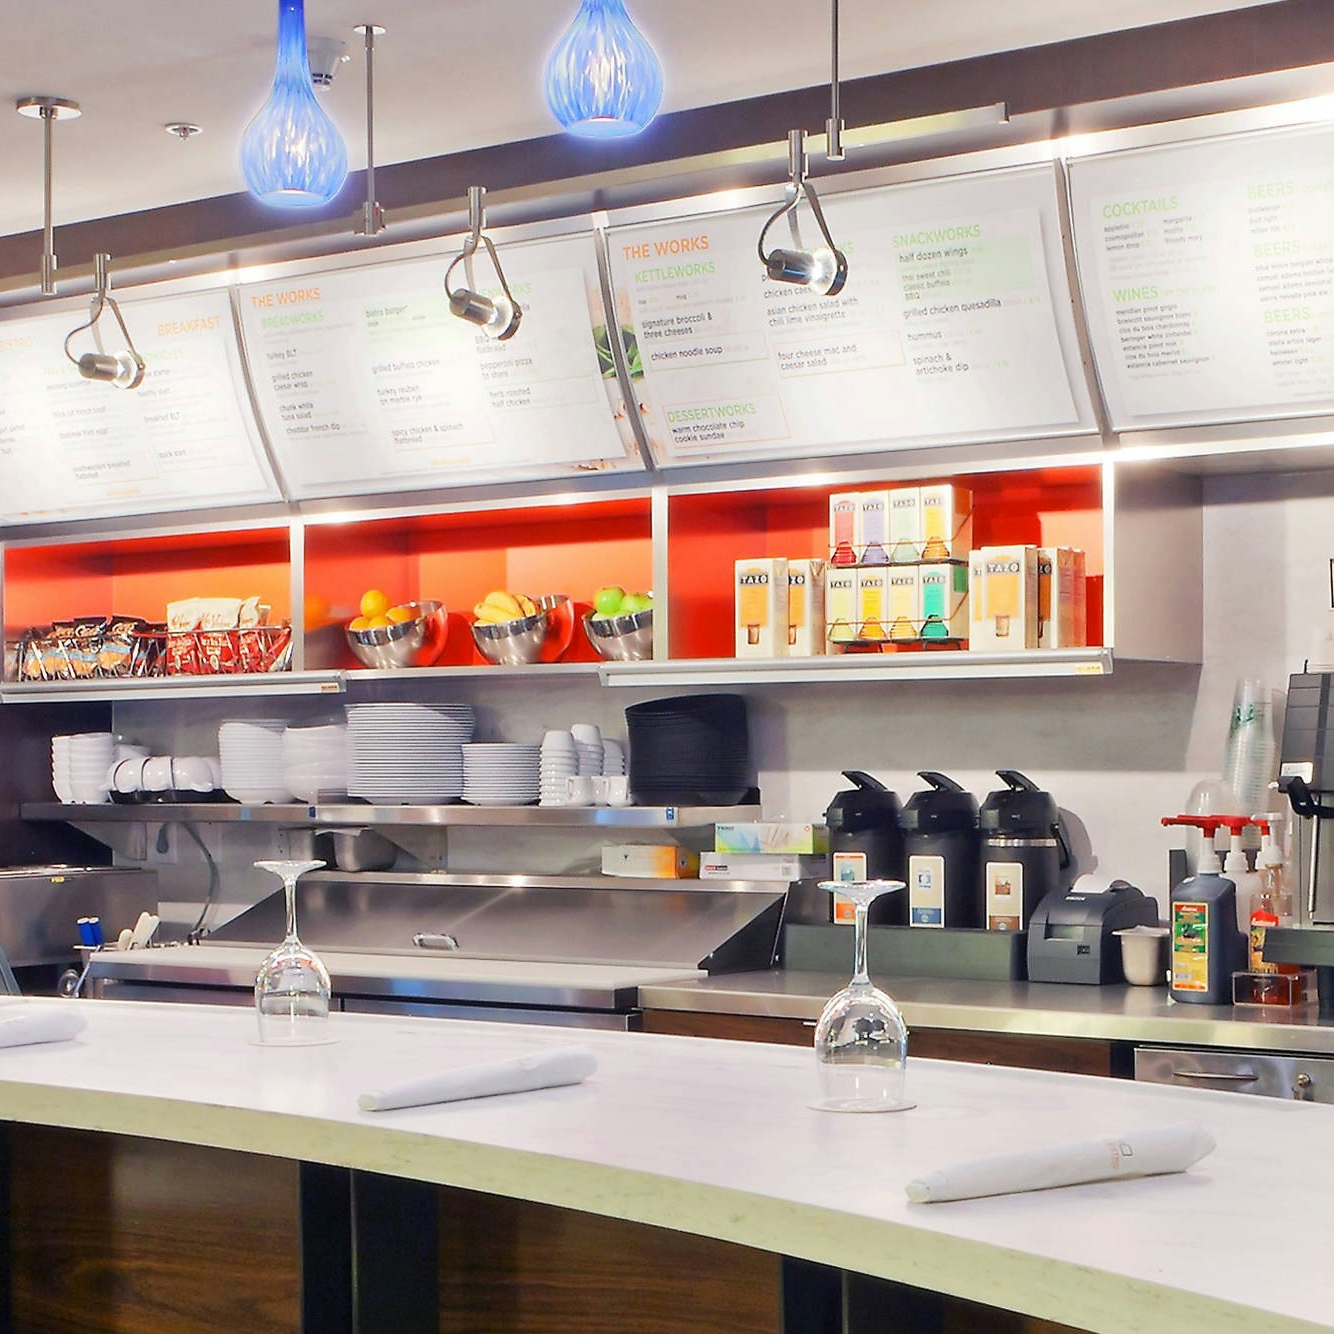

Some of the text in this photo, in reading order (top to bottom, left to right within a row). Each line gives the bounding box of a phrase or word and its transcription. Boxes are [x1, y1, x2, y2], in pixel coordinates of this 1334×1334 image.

[1248, 181, 1294, 200] BEERS
[1103, 196, 1178, 219] COCKTAILS
[892, 225, 980, 248] SNACKWORKS
[623, 236, 709, 260] THE WORKS
[917, 250, 942, 260] dozen
[944, 247, 968, 256] wings
[1254, 241, 1300, 258] BEERS
[635, 262, 715, 283] KETTLEWORKS
[252, 287, 321, 308] THE WORKS
[1113, 286, 1158, 303] WINES
[805, 311, 845, 323] vinaigrette
[903, 307, 928, 320] grilled
[961, 298, 1001, 312] quesadilla
[1264, 307, 1311, 325] BEERS
[157, 317, 219, 337] BREAKFAST
[260, 310, 323, 329] BREADWORKS
[642, 317, 674, 329] signature
[676, 313, 705, 325] broccoli
[644, 330, 662, 338] three
[651, 351, 677, 361] chicken
[666, 403, 756, 423] DESSERTWORKS
[987, 563, 1019, 573] TAZO
[740, 575, 768, 584] TAZO
[789, 575, 804, 584] ZO
